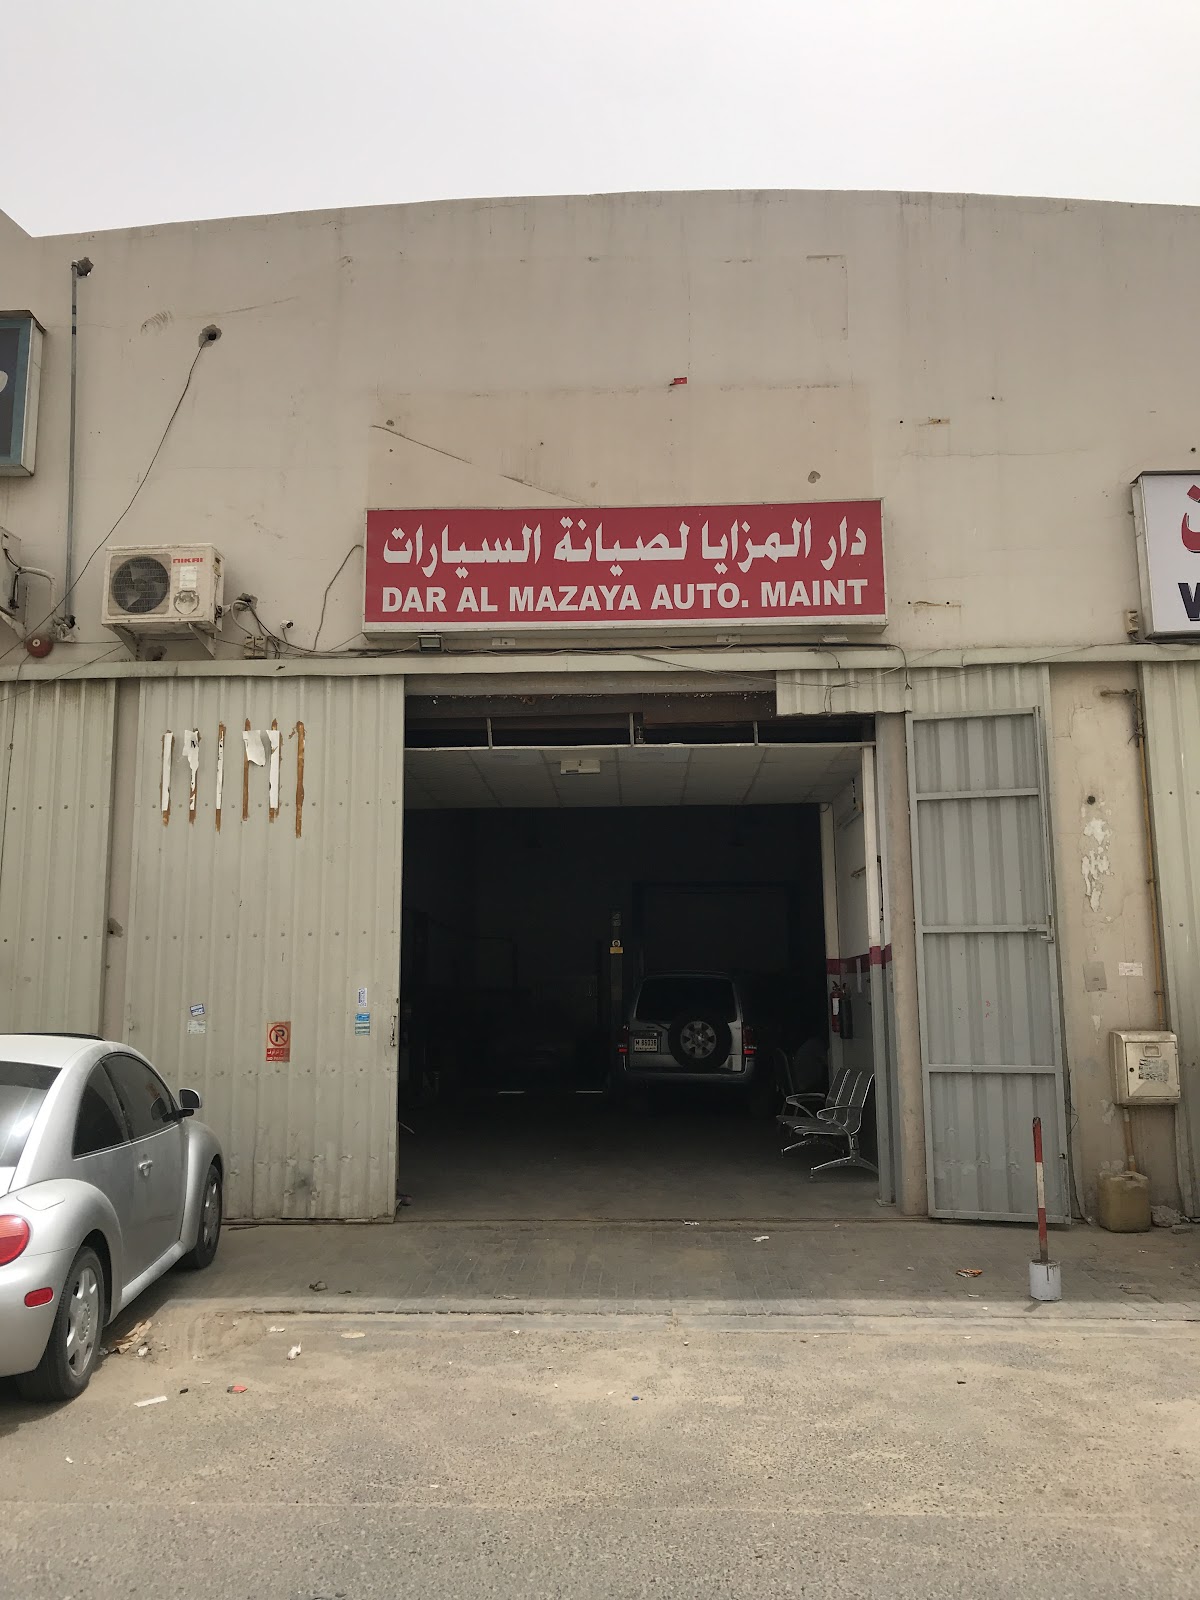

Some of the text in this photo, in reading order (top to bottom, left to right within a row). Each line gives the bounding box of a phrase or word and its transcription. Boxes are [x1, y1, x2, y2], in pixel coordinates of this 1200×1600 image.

[383, 515, 867, 579] دار المزايا لصيانة السيارات
[382, 579, 868, 613] DAR AL MAZAYA AUTO. MAINT
